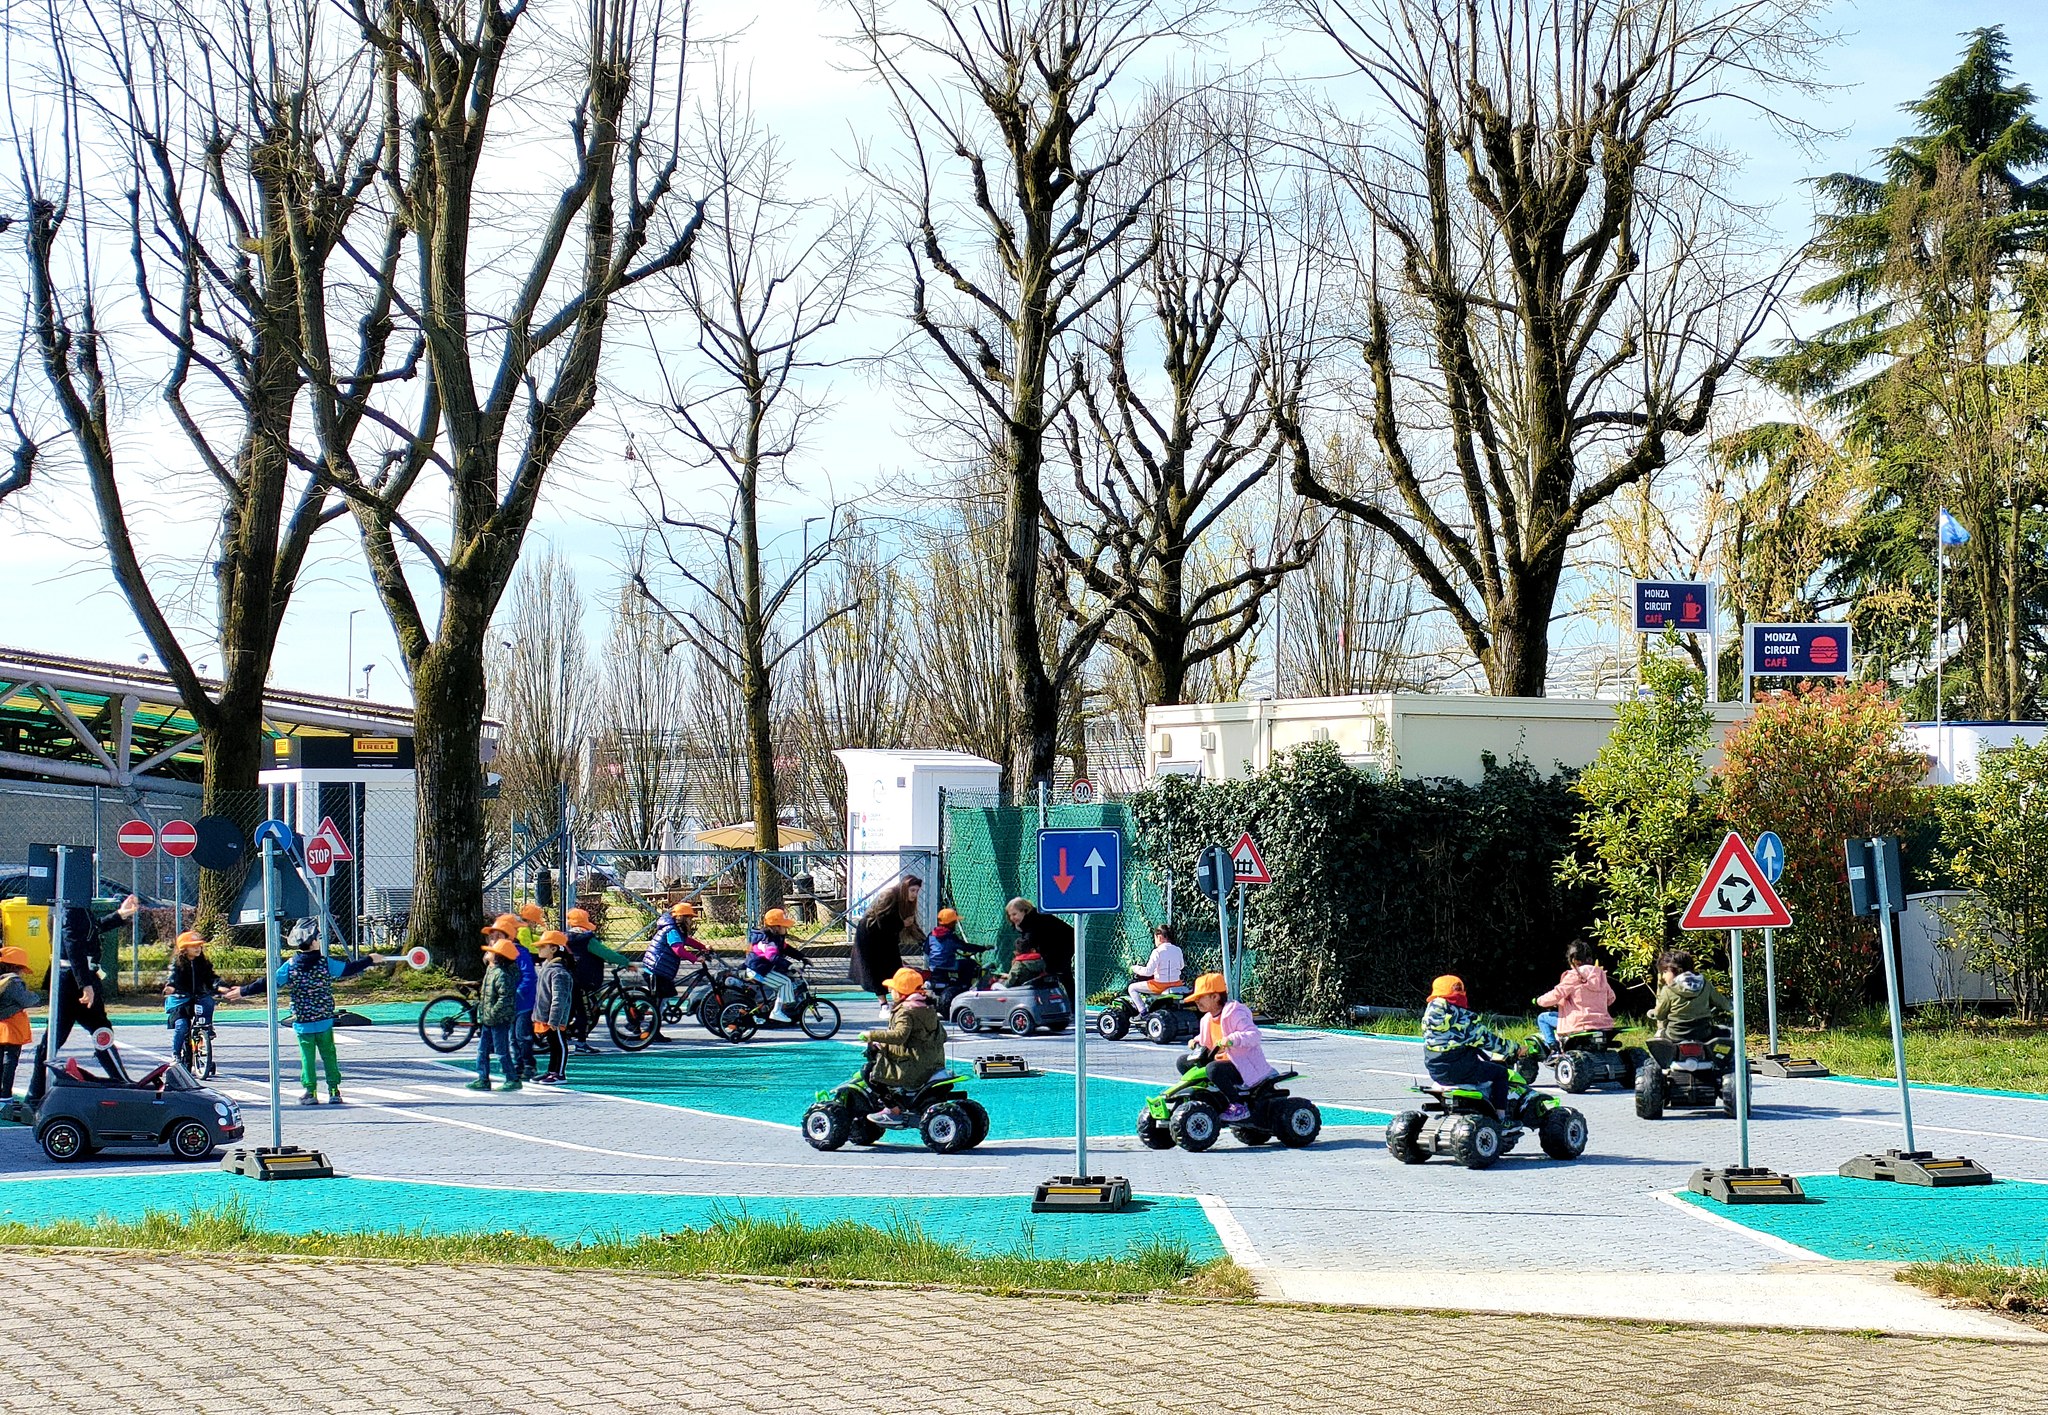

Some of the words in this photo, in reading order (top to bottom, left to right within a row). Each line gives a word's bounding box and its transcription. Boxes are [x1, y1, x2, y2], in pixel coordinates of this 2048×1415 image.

[1644, 589, 1670, 598] MONZA
[1644, 602, 1672, 611] CIRCUIT
[1764, 633, 1798, 642] MONZA
[1764, 645, 1800, 655] CIRCUIT
[357, 740, 394, 750] PIRELLI
[1076, 785, 1089, 798] 30
[309, 848, 330, 865] STOP
